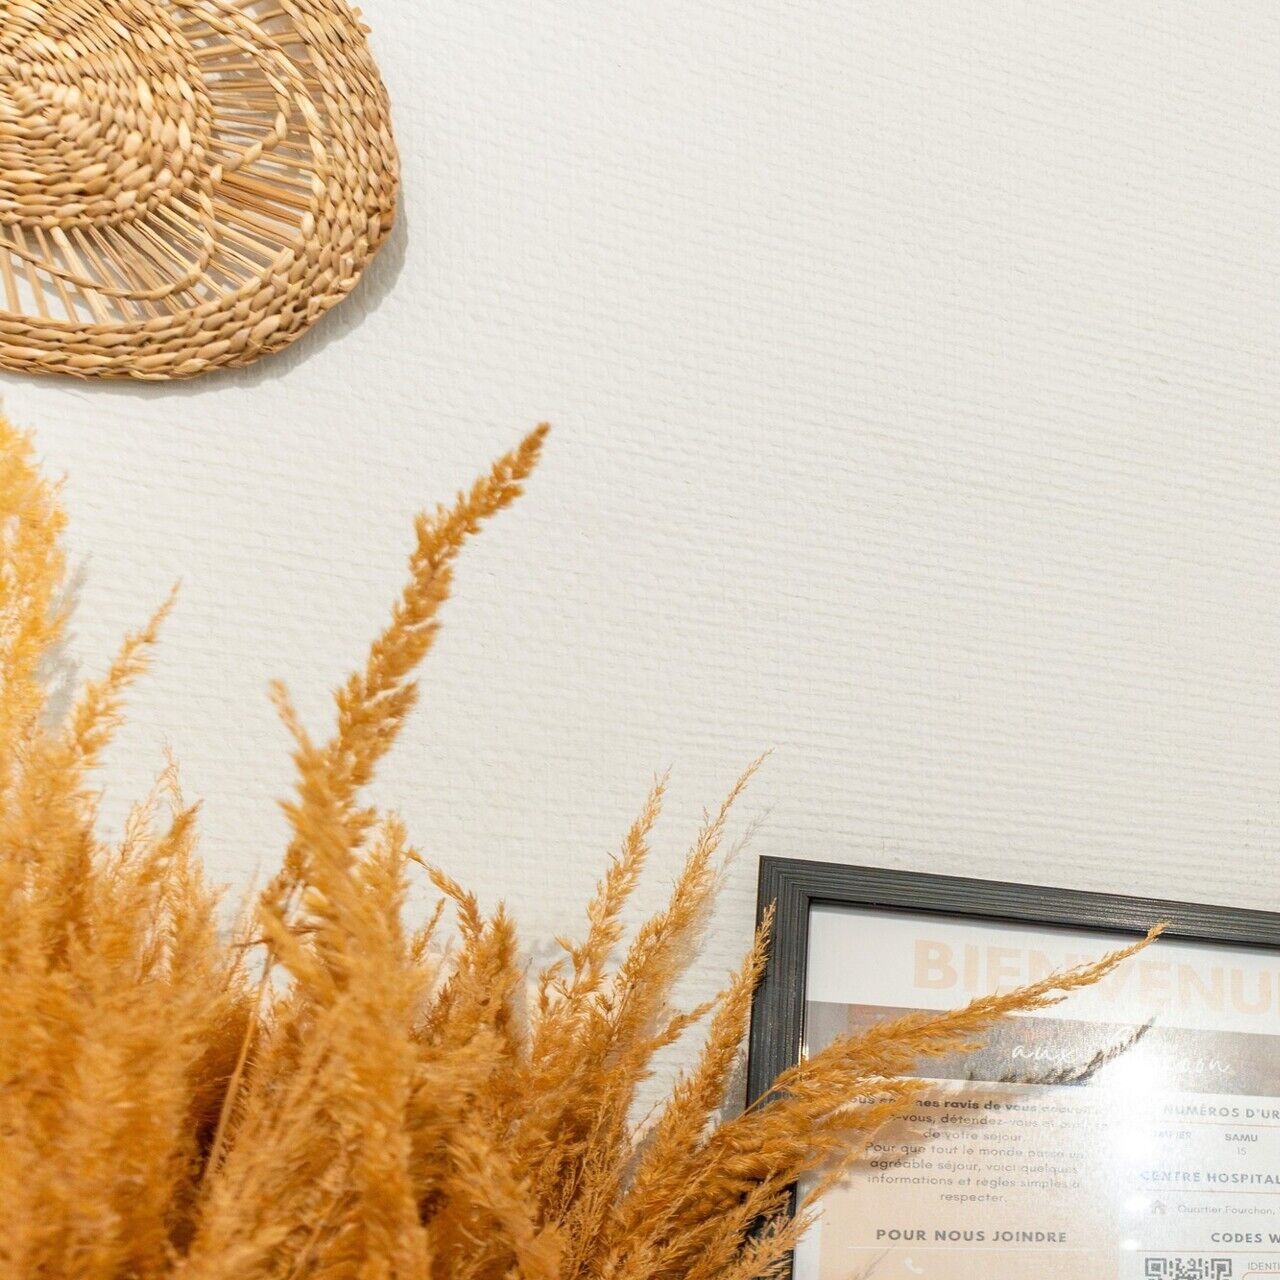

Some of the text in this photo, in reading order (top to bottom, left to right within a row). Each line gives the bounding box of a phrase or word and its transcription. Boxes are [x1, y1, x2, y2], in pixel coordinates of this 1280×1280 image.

[944, 1099, 979, 1109] ravis
[984, 1100, 1001, 1110] de
[1163, 1103, 1240, 1118] NUMÉROS
[923, 1128, 940, 1139] de
[1225, 1133, 1258, 1143] SAMU
[865, 1142, 896, 1153] Pour
[901, 1146, 926, 1156] que
[931, 1145, 958, 1155] tout
[963, 1145, 975, 1155] le
[978, 1146, 1023, 1157] monde
[1237, 1147, 1247, 1156] 15
[870, 1158, 933, 1172] agréable
[937, 1161, 981, 1174] séjour,
[986, 1162, 1016, 1172] voici
[867, 1175, 953, 1186] informations
[958, 1176, 971, 1186] et
[1020, 1177, 1067, 1190] simples
[1140, 1170, 1201, 1183] CENTRE
[940, 1192, 1008, 1204] respecter.
[1177, 1204, 1222, 1215] Quartier
[876, 1229, 1067, 1243] POUR NOUS JOINDRE
[1211, 1232, 1263, 1244] CODES
